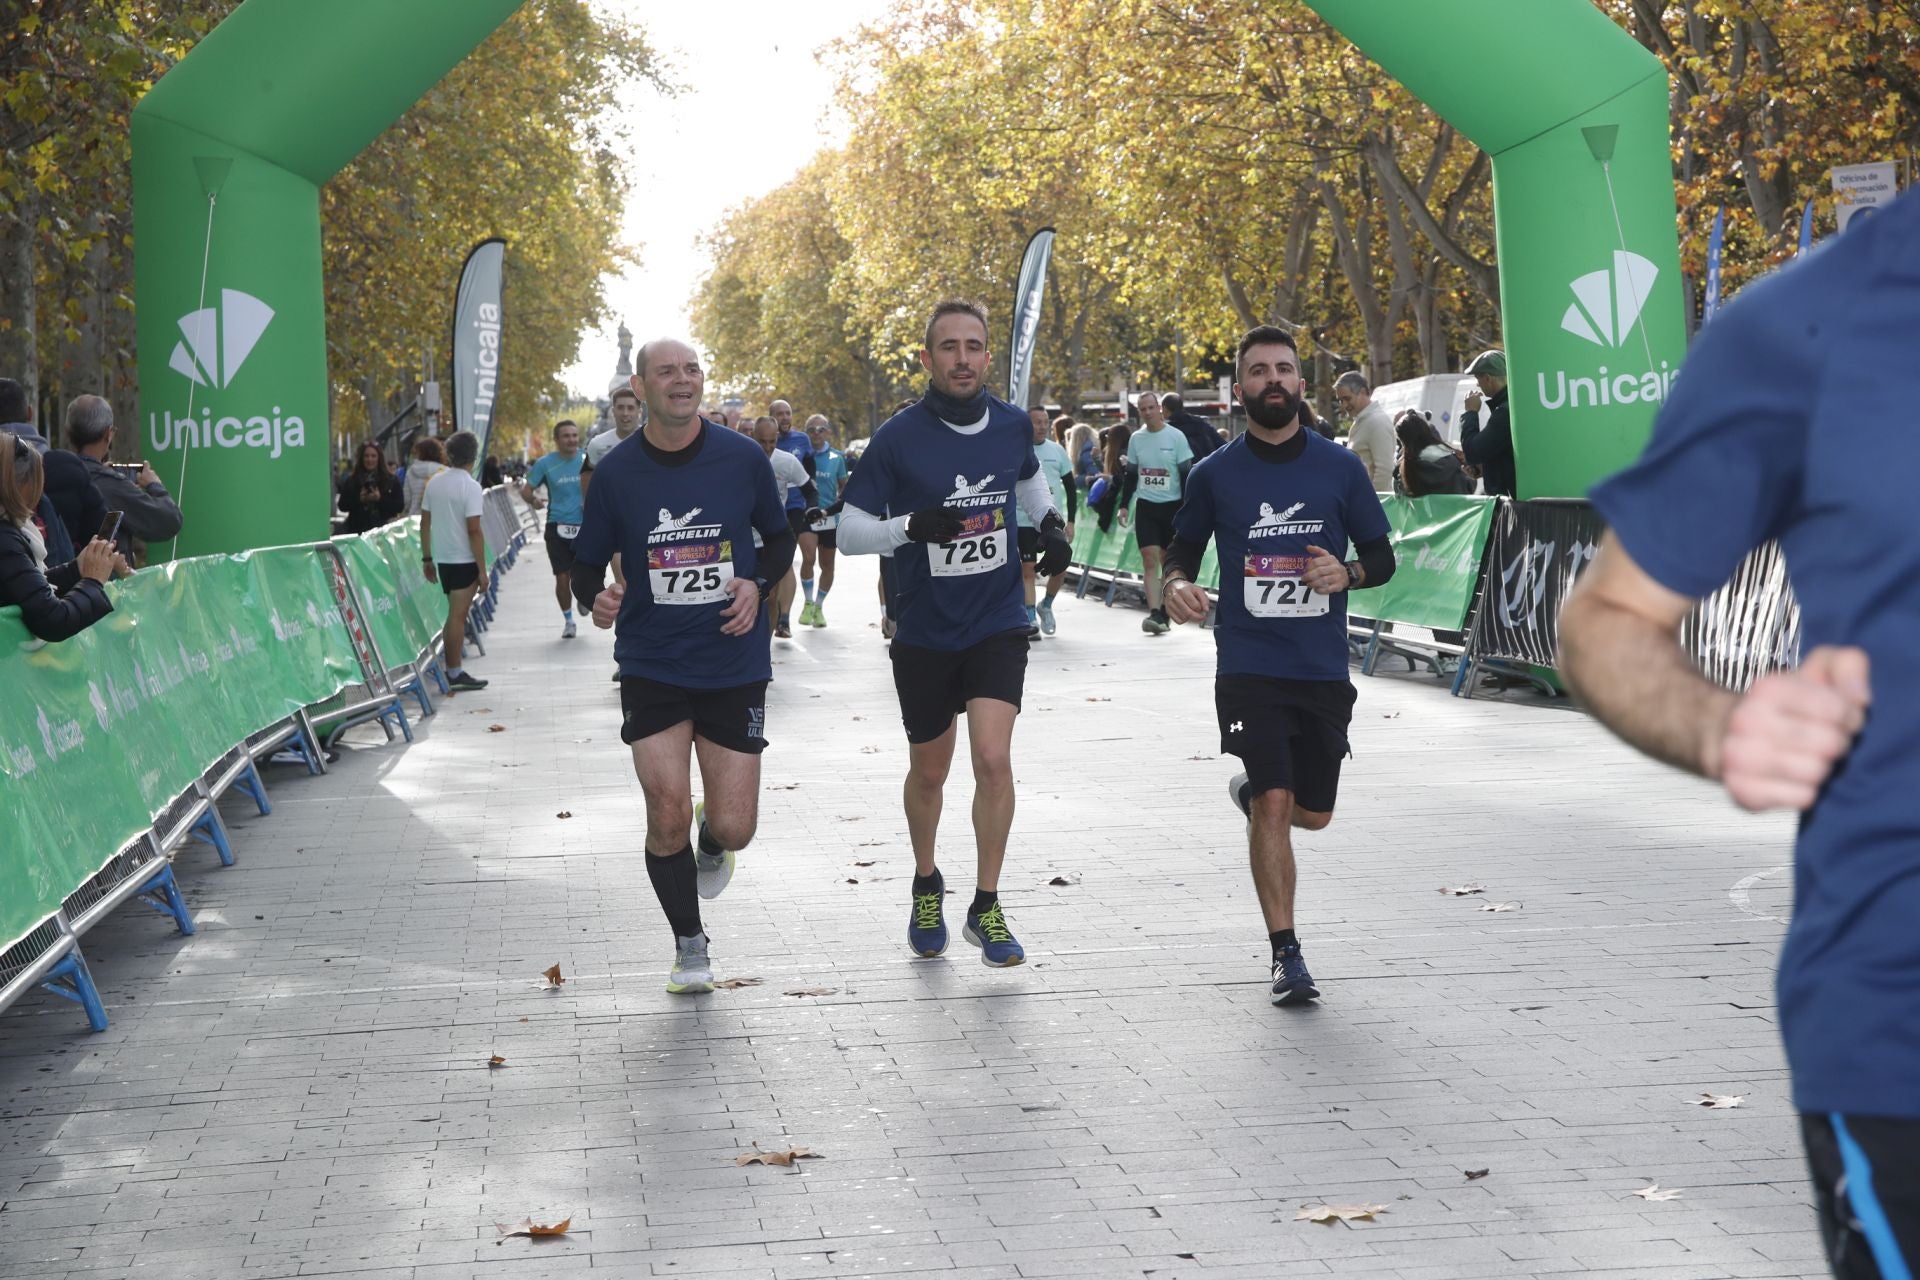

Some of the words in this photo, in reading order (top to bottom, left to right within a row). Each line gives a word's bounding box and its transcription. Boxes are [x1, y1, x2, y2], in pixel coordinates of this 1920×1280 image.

[1840, 174, 1867, 183] Oficina
[1868, 172, 1878, 180] de
[150, 405, 305, 459] Unicaja
[1144, 477, 1165, 485] 844
[943, 495, 1007, 508] MICHELIN
[648, 528, 721, 544] MICHELIN
[1248, 524, 1323, 539] MICHELIN
[676, 552, 706, 560] EMPRESAS
[940, 536, 996, 565] 726
[662, 567, 720, 593] 725
[1257, 580, 1313, 604] 727
